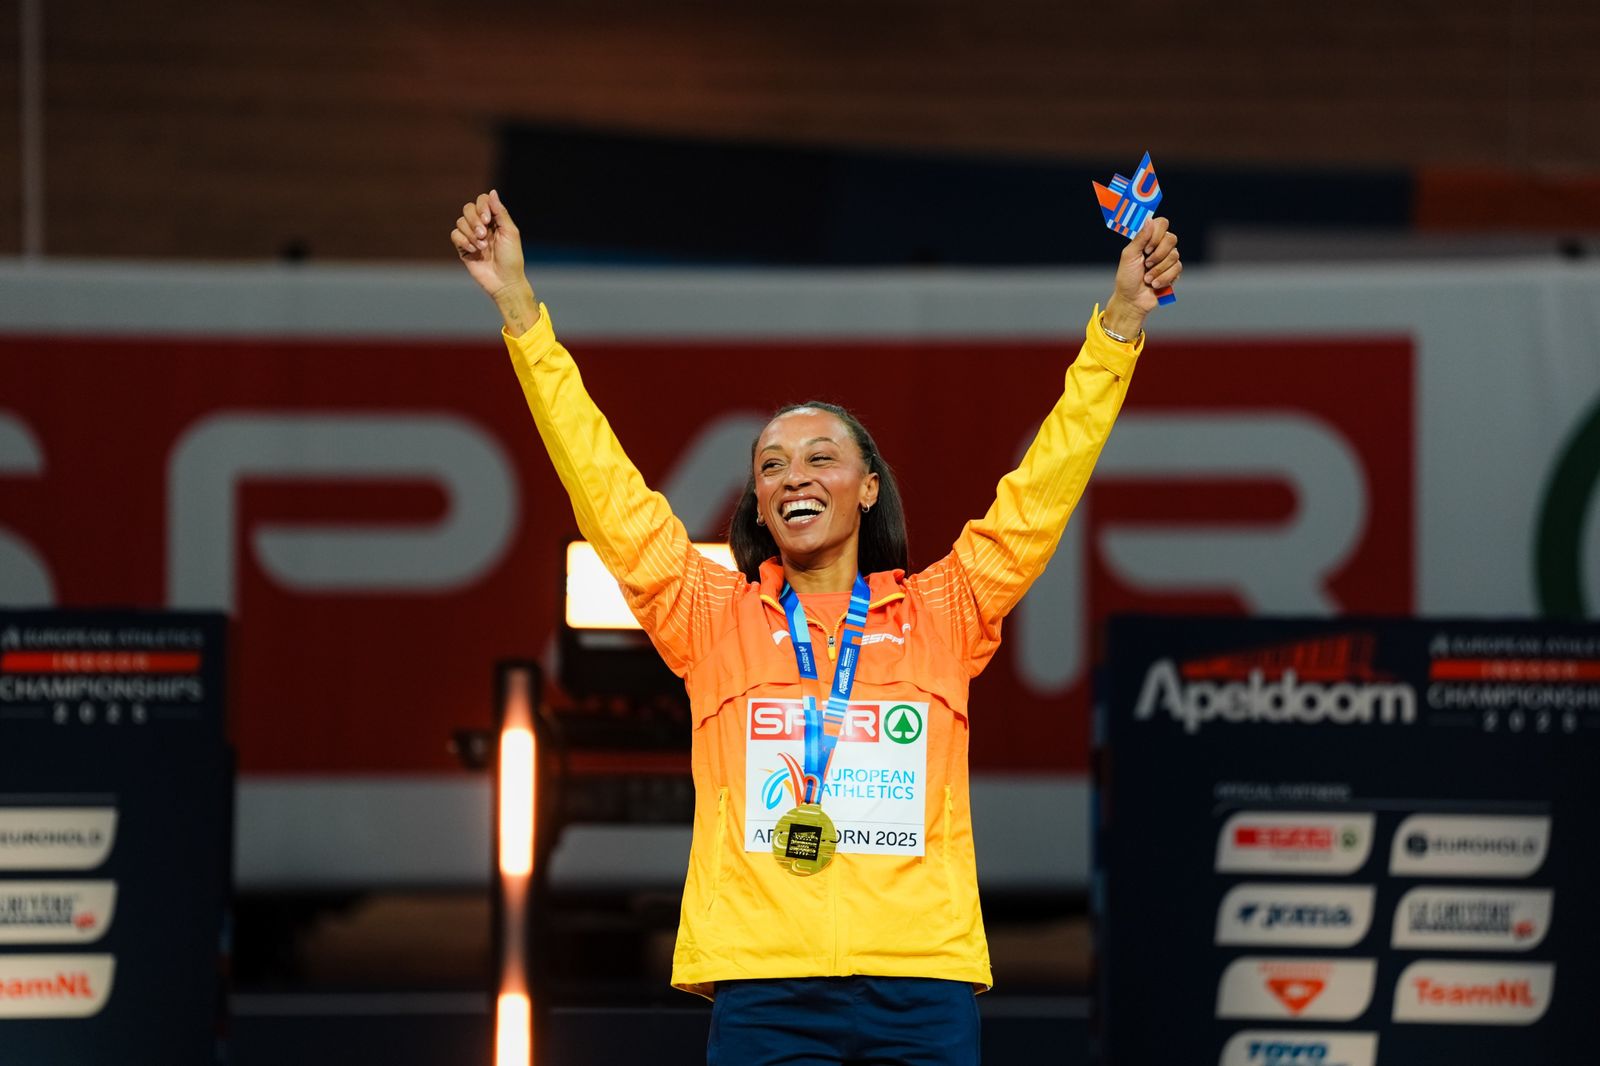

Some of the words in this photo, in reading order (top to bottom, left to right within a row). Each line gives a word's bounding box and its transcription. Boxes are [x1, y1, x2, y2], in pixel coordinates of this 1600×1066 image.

[1135, 659, 1416, 733] Apeldoorn
[754, 707, 877, 737] SPR
[827, 768, 914, 784] UROPEAN
[823, 783, 914, 800] ATHLETICS
[875, 831, 917, 847] 2025
[1415, 976, 1536, 1008] TeamNL
